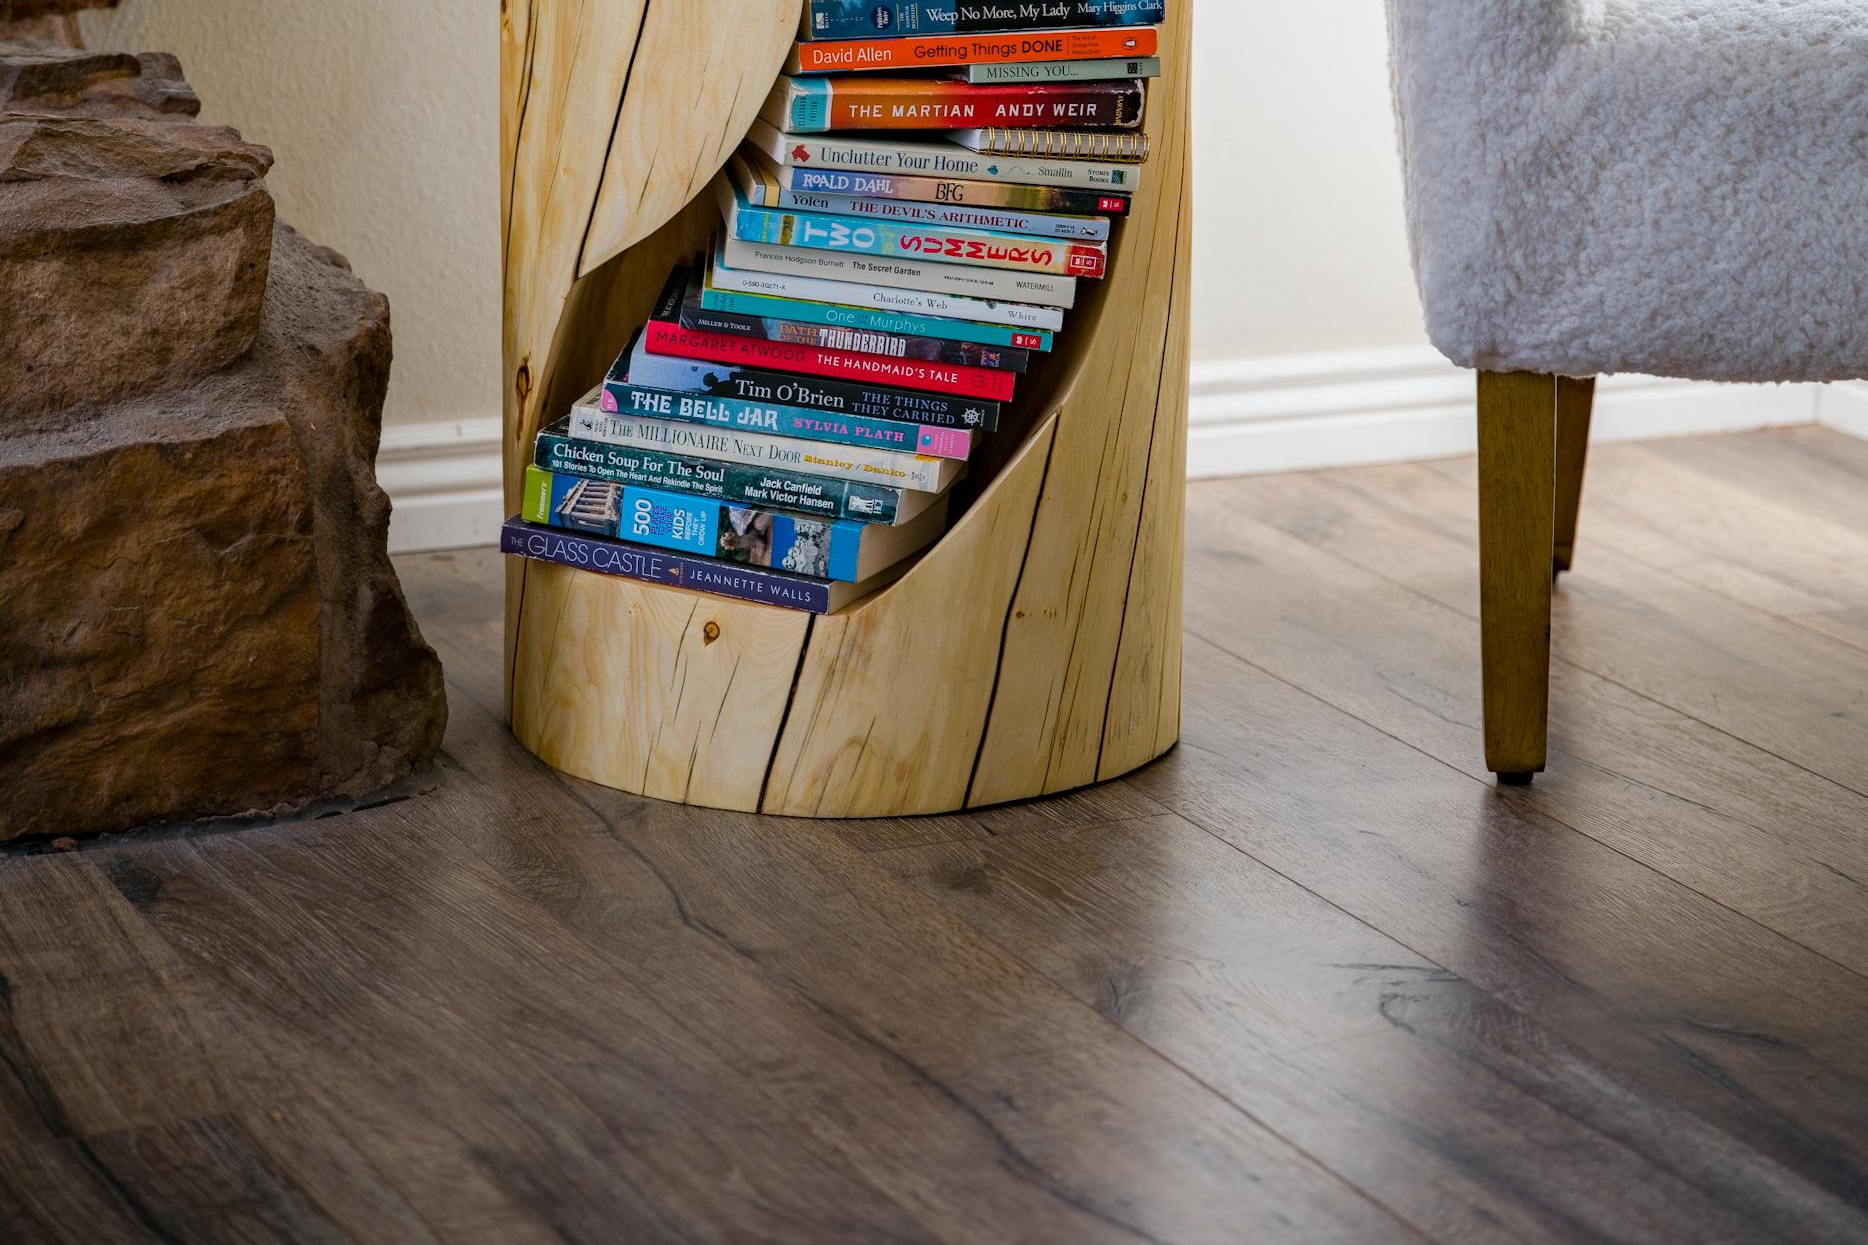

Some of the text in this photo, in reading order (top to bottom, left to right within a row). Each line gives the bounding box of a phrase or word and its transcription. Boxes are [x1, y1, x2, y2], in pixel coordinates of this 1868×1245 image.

[926, 2, 1071, 25] Weep No More, My Lady
[1077, 2, 1103, 17] Mary
[1103, 0, 1137, 15] Higgins
[813, 46, 892, 64] David Allen
[913, 39, 1063, 59] Getting Things DONE
[1072, 48, 1102, 56] Productivity
[987, 65, 1080, 79] MISSING YOU...
[849, 103, 975, 118] THE MARTIAN
[995, 103, 1097, 118] ANDY WEIR
[821, 146, 979, 173] Unclutter Your Home
[802, 173, 894, 194] ROALD DAHL
[1038, 166, 1073, 179] Smallin
[1088, 175, 1109, 184] BOOKS
[792, 194, 830, 209] Yolen
[935, 181, 965, 202] BFG
[849, 200, 1030, 230] THE DEVIL'S ARITHMETIC
[804, 220, 876, 248] TWO
[753, 250, 845, 268] Frances Hodgson Burnett
[899, 234, 1053, 267] SUMMERS
[852, 261, 921, 277] The Secret Garden
[1016, 280, 1055, 292] WATERMILL
[873, 292, 949, 310] Charlotte's Web
[698, 318, 753, 332] MILLER & TOOLE
[826, 308, 928, 334] One Murphys
[1008, 309, 1038, 322] White
[780, 322, 818, 335] PATH
[796, 335, 817, 345] THE
[655, 330, 807, 362] MARGARET ATWOOD
[819, 327, 907, 358] THUNDERBIRD
[817, 353, 959, 385] THE HANDMAID'S TALE
[735, 378, 845, 409] Tim O'Brien
[862, 390, 949, 413] THE THINGS
[631, 390, 673, 415] THE
[679, 397, 730, 423] BELL
[736, 406, 780, 432] JAR
[851, 402, 956, 425] THEY CARRIED
[793, 417, 905, 443] SYLVIA PLATH
[636, 423, 729, 453] MILLIONAIRE
[731, 438, 765, 459] NEXT
[768, 443, 802, 464] DOOR
[553, 442, 725, 483] Chicken Soup For The Soul
[803, 454, 854, 471] Stanley
[862, 462, 907, 479] Danko
[551, 460, 723, 494] 101 Stories To Open The Heart And Rekindle The Spirit
[759, 477, 822, 496] Jack Canfield
[744, 485, 835, 510] Mark Victor Hansen
[633, 498, 652, 536] 500
[651, 505, 660, 535] PLACES
[657, 506, 668, 536] TO TAKE
[665, 511, 674, 532] YOUR
[672, 508, 686, 540] KIDS
[684, 511, 693, 541] BEFORE
[691, 517, 699, 537] THEY
[697, 510, 708, 546] GROW UP
[510, 535, 525, 548] THE
[527, 534, 589, 564] GLASS
[592, 547, 663, 579] CASTLE
[690, 569, 764, 594] JEANNETTE
[769, 584, 812, 603] WALLS
